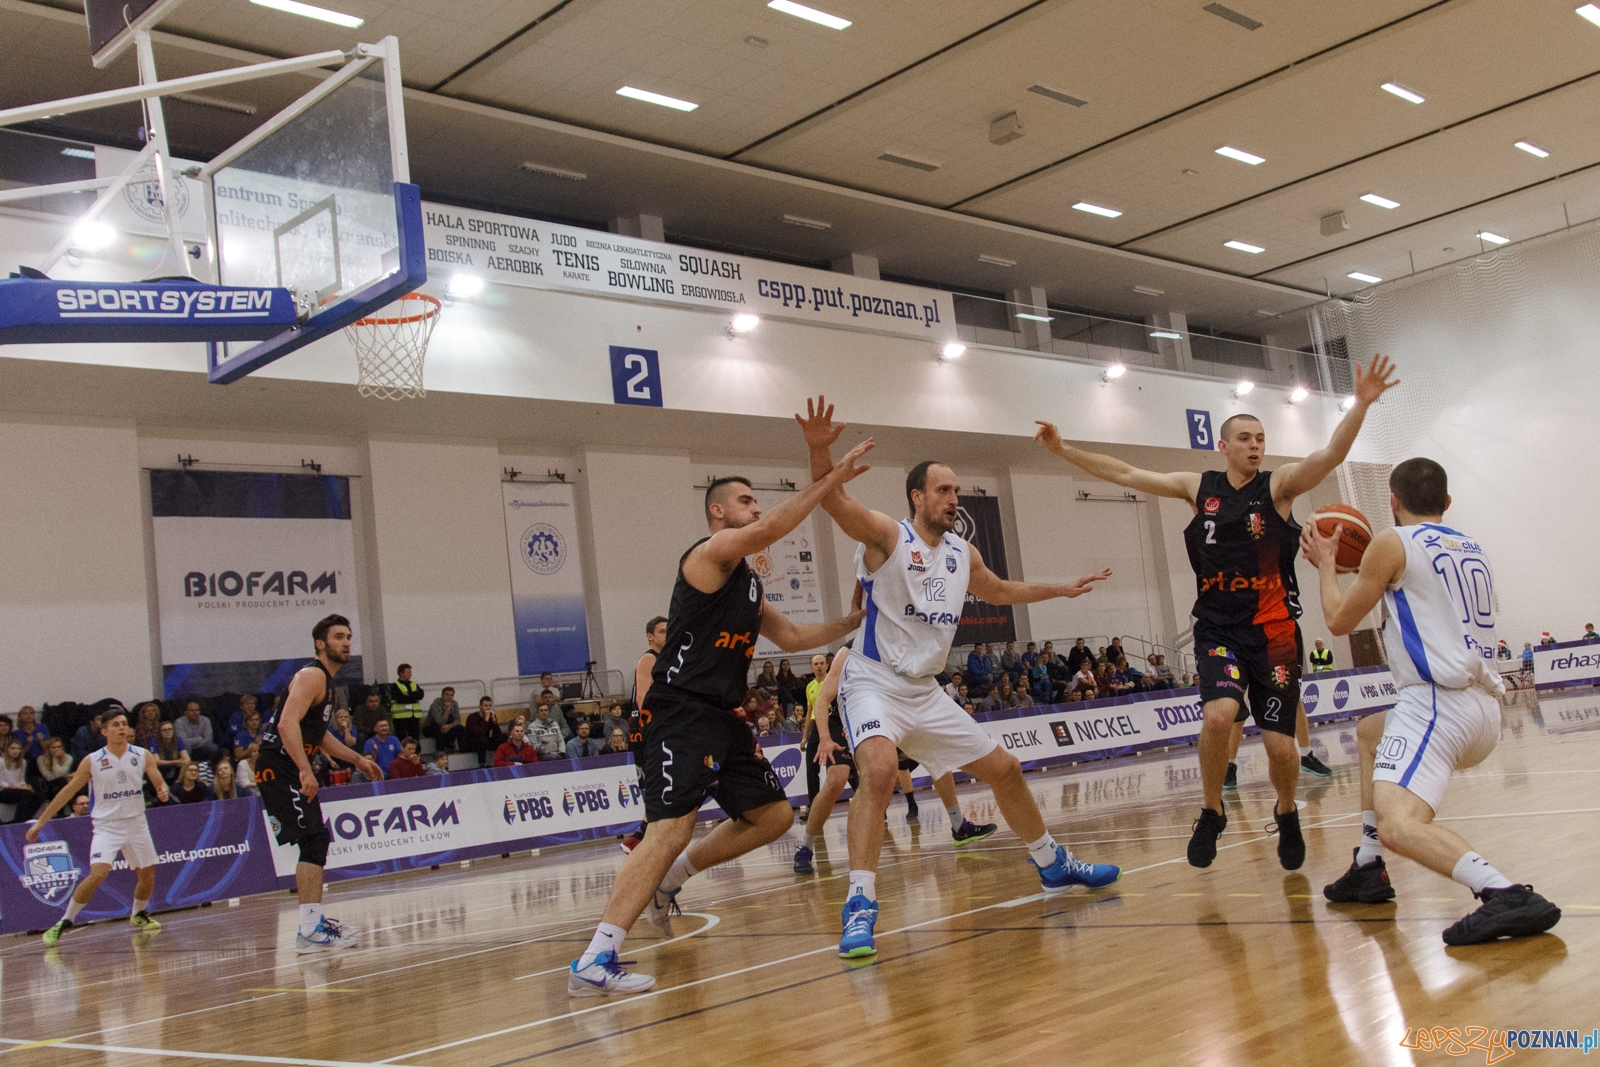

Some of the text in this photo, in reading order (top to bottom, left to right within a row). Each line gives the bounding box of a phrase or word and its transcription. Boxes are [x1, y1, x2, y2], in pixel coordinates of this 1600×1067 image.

[426, 211, 540, 242] HALA SPORTOWA
[445, 234, 496, 252] SPININNG
[508, 244, 540, 257] SZACHY
[551, 233, 577, 248] JUDO
[427, 247, 544, 276] BOISKA AEROBIK
[552, 249, 600, 272] TENIS
[620, 258, 667, 275] SIŁOWNIA
[678, 254, 742, 281] SQUASH
[562, 270, 591, 282] KARATE
[607, 270, 675, 295] BOWLING
[681, 283, 746, 305] ERGOWIOSŁA
[757, 278, 941, 328] cspp.put.poznan.pl
[624, 353, 651, 400] 2
[1193, 413, 1209, 446] 3
[1203, 520, 1217, 544] 2
[923, 577, 946, 602] 12
[1432, 553, 1495, 628] 10
[197, 597, 326, 610] POLSKI PRODUCENT LEKÓW
[1263, 696, 1282, 723] 2
[861, 719, 881, 733] PBG
[1002, 729, 1043, 750] DELIK
[1074, 714, 1141, 742] NICKEL
[116, 769, 127, 785] 9
[571, 781, 606, 792] fundacja
[513, 789, 549, 799] fundacja
[574, 788, 611, 814] PBG
[324, 799, 460, 843] IOFARM
[516, 796, 554, 822] PBG
[326, 830, 451, 857] OLSKI PRODUCENT LEKÓW
[21, 869, 79, 887] BASKET
